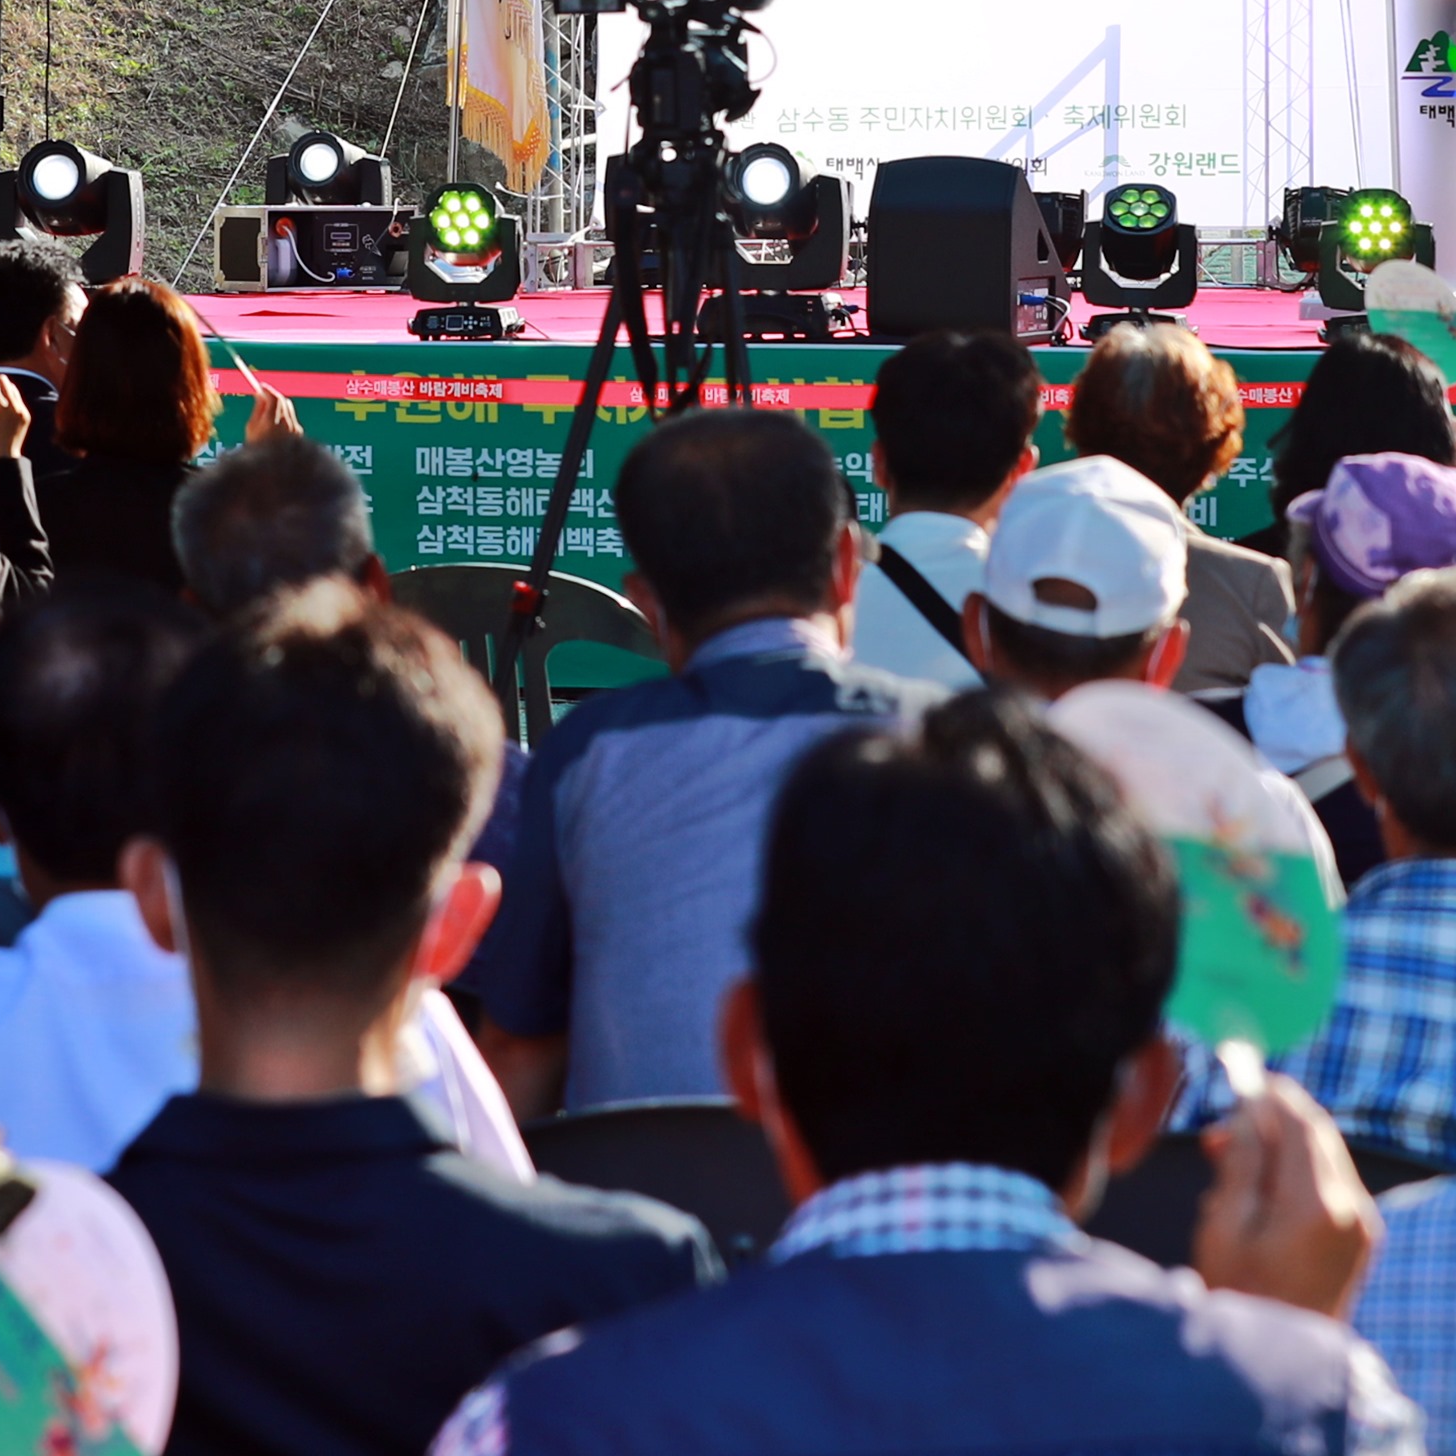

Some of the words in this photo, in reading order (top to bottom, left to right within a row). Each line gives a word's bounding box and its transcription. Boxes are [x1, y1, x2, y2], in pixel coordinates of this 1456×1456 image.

[777, 106, 850, 133] 삼수동
[859, 104, 1034, 132] 주민자치위원회
[1062, 104, 1188, 130] 축제위원회
[1148, 152, 1241, 177] 강원랜드
[346, 378, 415, 396] 삼수매봉산
[419, 380, 503, 399] 바람개비축제
